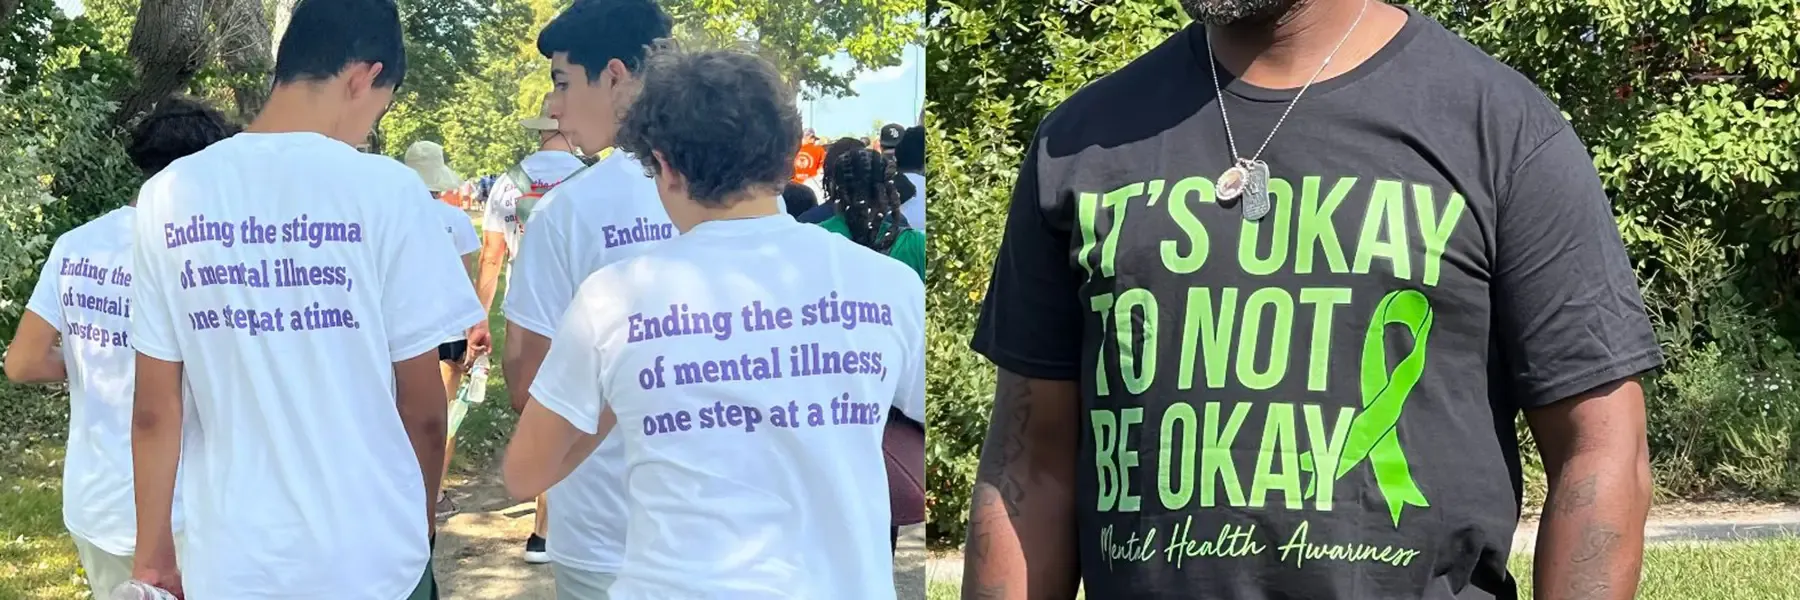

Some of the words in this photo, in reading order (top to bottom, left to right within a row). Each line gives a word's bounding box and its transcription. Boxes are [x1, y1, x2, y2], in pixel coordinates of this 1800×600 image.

[164, 214, 235, 249] Ending
[241, 215, 277, 244] the
[282, 213, 362, 249] stigma
[1078, 176, 1217, 283] IT'S
[1237, 176, 1466, 287] OKAY
[60, 257, 108, 286] Ending
[111, 265, 132, 287] the
[181, 259, 196, 290] of
[198, 259, 270, 289] mental
[274, 258, 353, 293] illness,
[63, 286, 74, 307] of
[260, 307, 285, 332] at
[290, 310, 304, 331] a
[304, 301, 361, 330] time.
[627, 303, 733, 344] Ending
[741, 300, 793, 333] the
[801, 291, 893, 330] stigma
[80, 323, 110, 348] step
[112, 331, 128, 348] at
[1090, 287, 1159, 397] TO
[1177, 287, 1353, 392] NOT
[639, 356, 666, 390] of
[674, 347, 783, 386] mental
[790, 343, 888, 382] illness,
[643, 409, 692, 436] one
[699, 401, 763, 433] step
[769, 400, 800, 428] at
[807, 402, 825, 426] a
[1090, 406, 1144, 512] BE
[1157, 401, 1356, 512] OKAY
[1100, 523, 1157, 573] Mental
[1164, 515, 1266, 569] Health
[1278, 520, 1421, 569] Awareness
